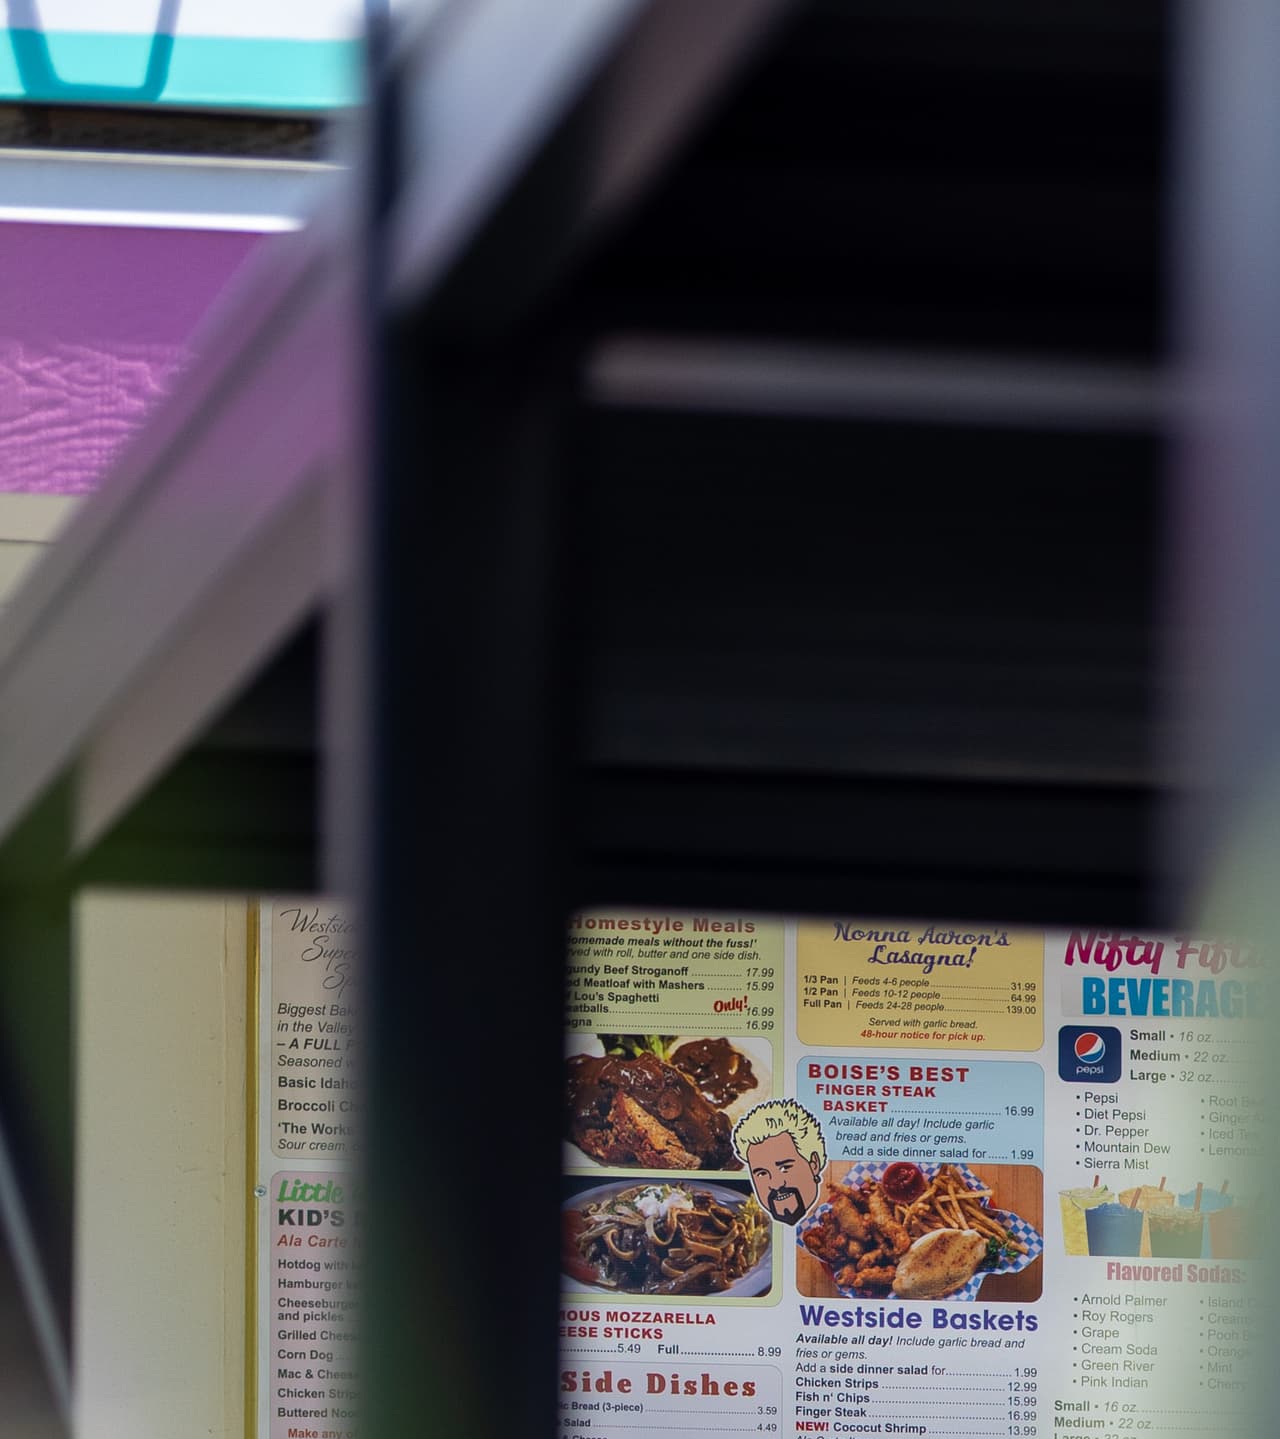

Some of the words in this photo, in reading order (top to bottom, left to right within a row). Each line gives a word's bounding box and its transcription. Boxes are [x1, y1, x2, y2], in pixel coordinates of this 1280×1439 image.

[693, 918, 755, 933] Meals
[918, 926, 1011, 946] Aaron's
[868, 945, 977, 974] Lasagna!
[747, 968, 774, 977] 17.99
[1130, 1029, 1165, 1041] Small
[1130, 1049, 1180, 1061] Medium
[809, 1064, 900, 1080] BOISE'S
[910, 1066, 969, 1082] BEST
[1076, 1066, 1104, 1075] pepsi
[1130, 1069, 1166, 1083] Large
[816, 1084, 876, 1096] FINGER
[882, 1086, 936, 1097] STEAK
[824, 1100, 888, 1112] BASKET
[1005, 1106, 1034, 1116] 16.99
[1084, 1107, 1109, 1120] Diet
[1112, 1109, 1146, 1123] Pepsi
[1084, 1124, 1102, 1136] Dr.
[1106, 1125, 1149, 1139] Pepper
[1084, 1141, 1139, 1153] Mountain
[1144, 1142, 1170, 1154] Dew
[278, 1208, 345, 1227] KID'S
[606, 1311, 716, 1325] MOZZARELLA
[799, 1305, 922, 1329] Westside
[933, 1308, 1038, 1331] Baskets
[604, 1327, 663, 1339] STICKS
[561, 1370, 633, 1395] Side
[646, 1373, 755, 1396] Dishes
[796, 1421, 829, 1431] NEW!
[885, 1423, 926, 1436] Shrimp
[1008, 1426, 1037, 1436] 13.99
